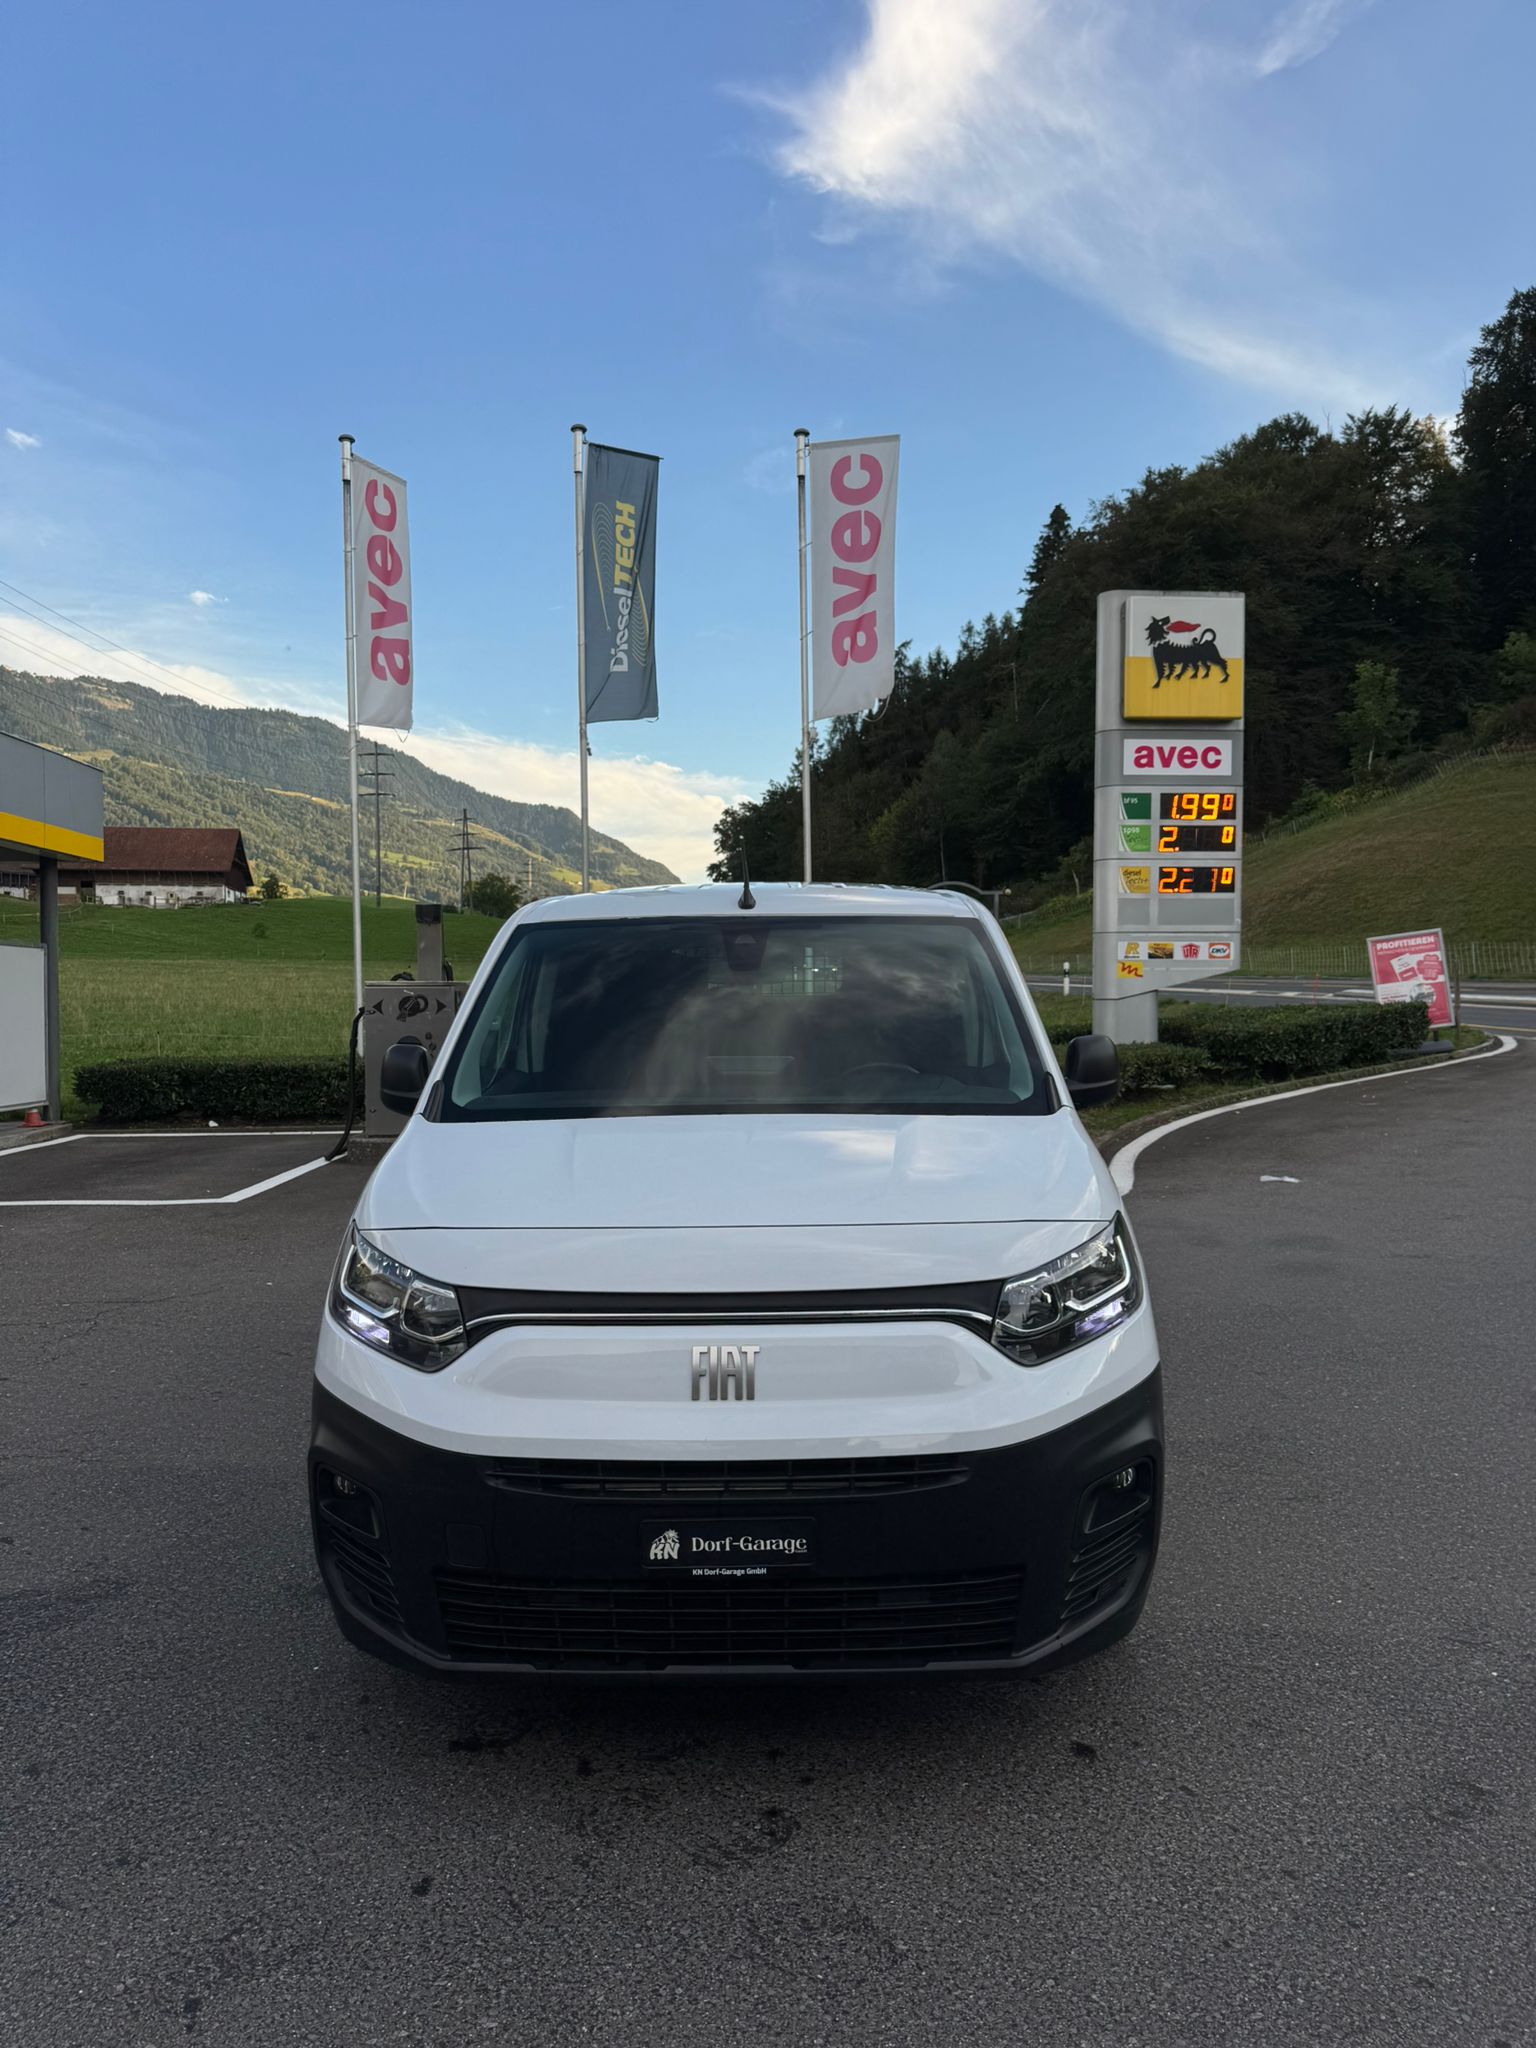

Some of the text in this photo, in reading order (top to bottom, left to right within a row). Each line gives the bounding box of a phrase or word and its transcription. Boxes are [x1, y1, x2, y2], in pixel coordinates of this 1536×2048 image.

[830, 453, 883, 667] avec
[365, 479, 411, 686] avec
[1133, 745, 1222, 769] avec
[1376, 935, 1435, 951] PROFITIEREN
[691, 1345, 760, 1401] FIAT
[650, 1536, 808, 1560] KN Dorf-Garage
[692, 1567, 767, 1577] KN Dorf-Garage GmbH
